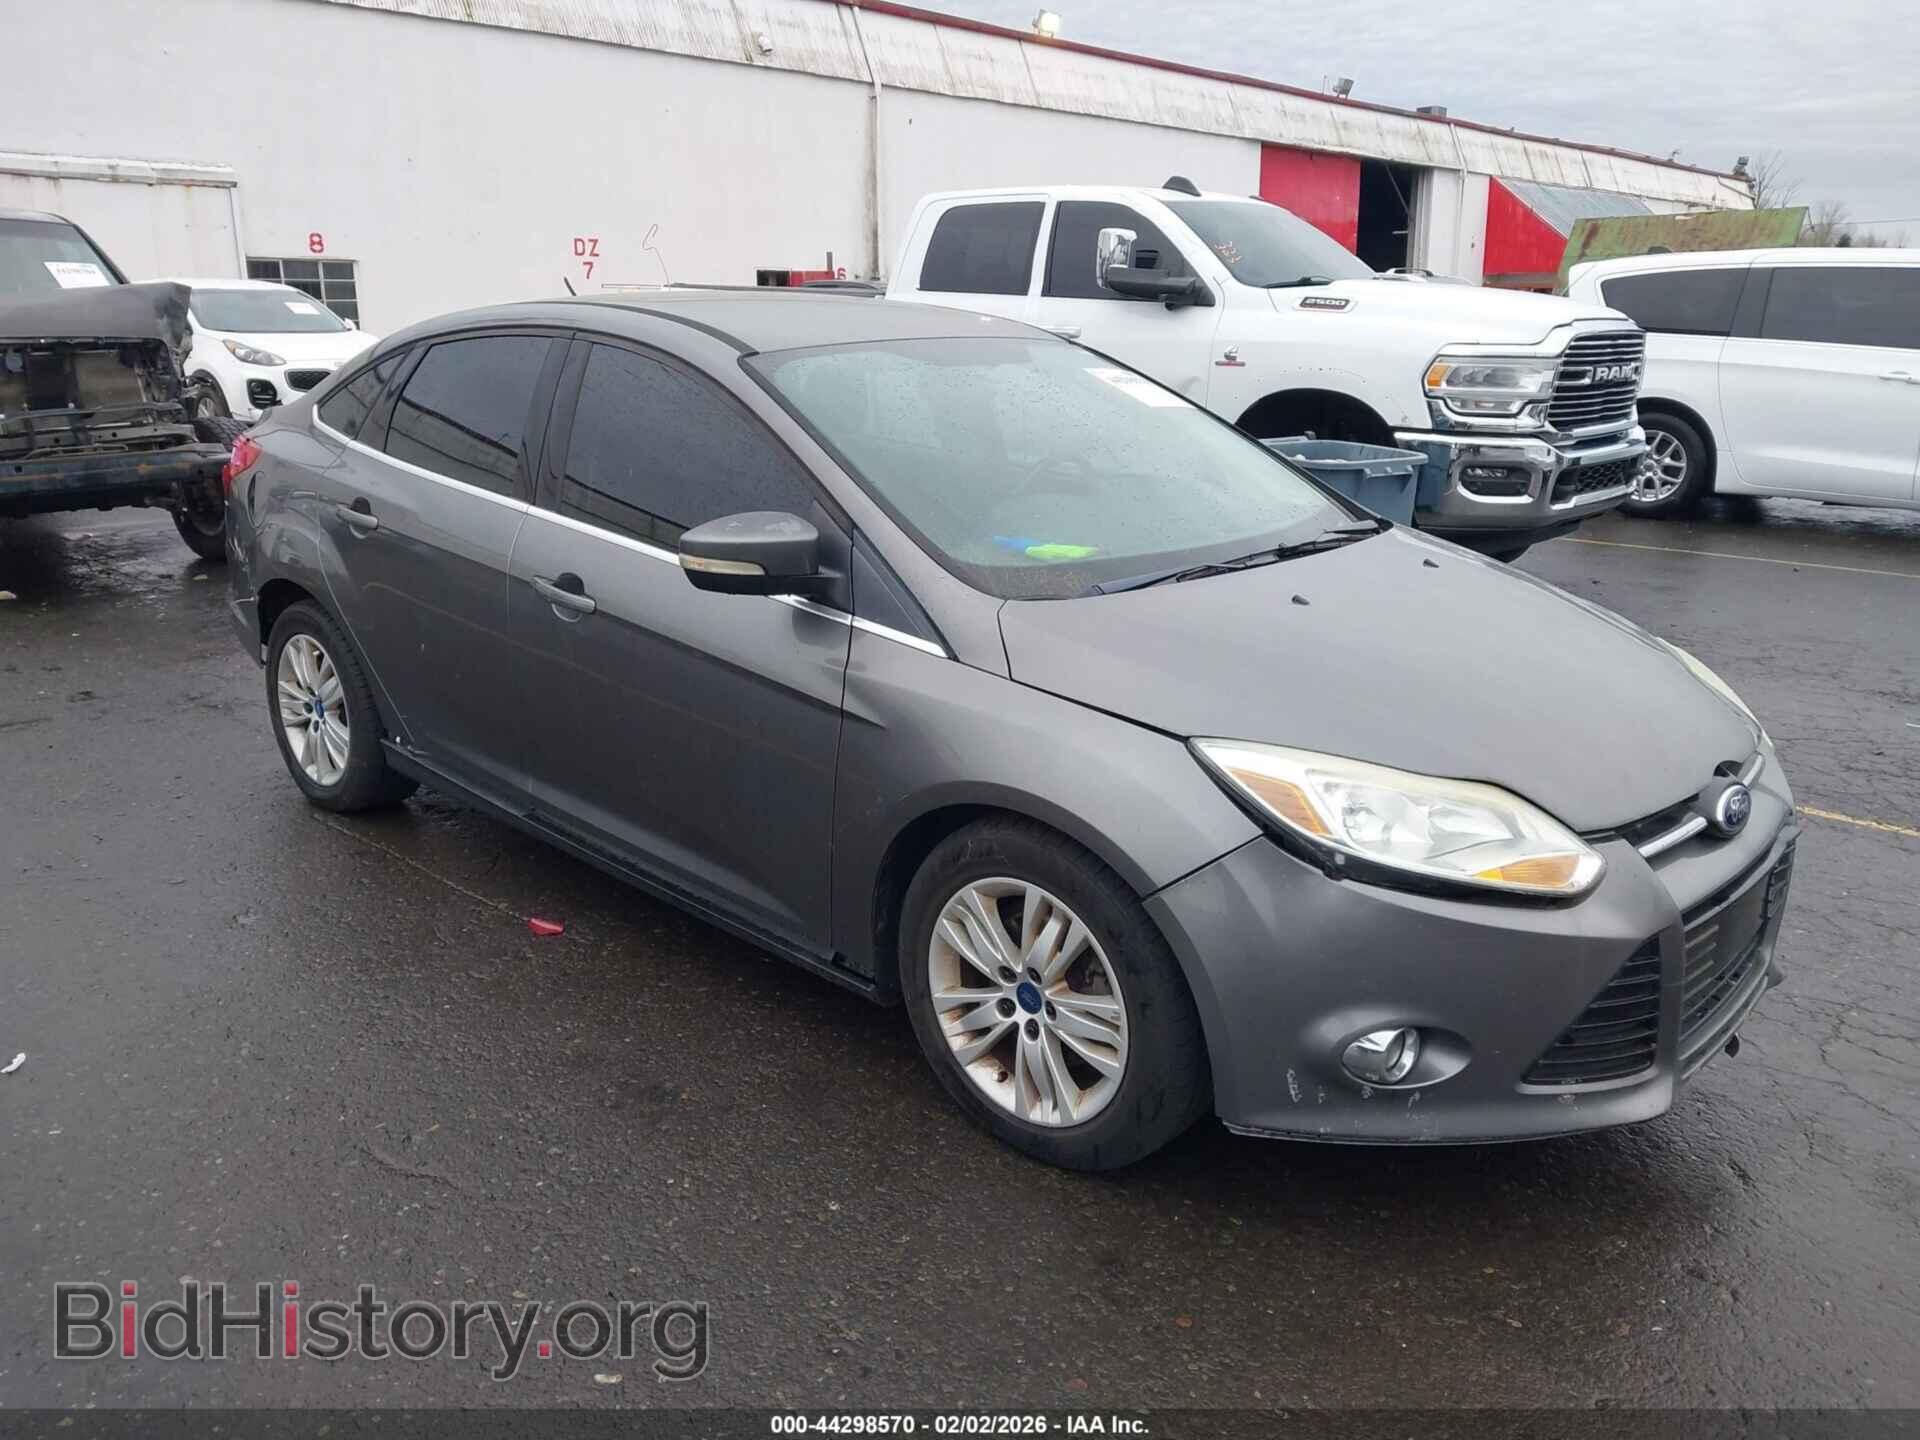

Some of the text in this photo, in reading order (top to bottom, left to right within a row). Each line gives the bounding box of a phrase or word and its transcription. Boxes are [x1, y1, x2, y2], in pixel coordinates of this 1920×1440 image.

[309, 232, 324, 253] 8
[574, 238, 600, 256] DZ
[583, 261, 593, 279] 7
[1595, 365, 1633, 380] RAM
